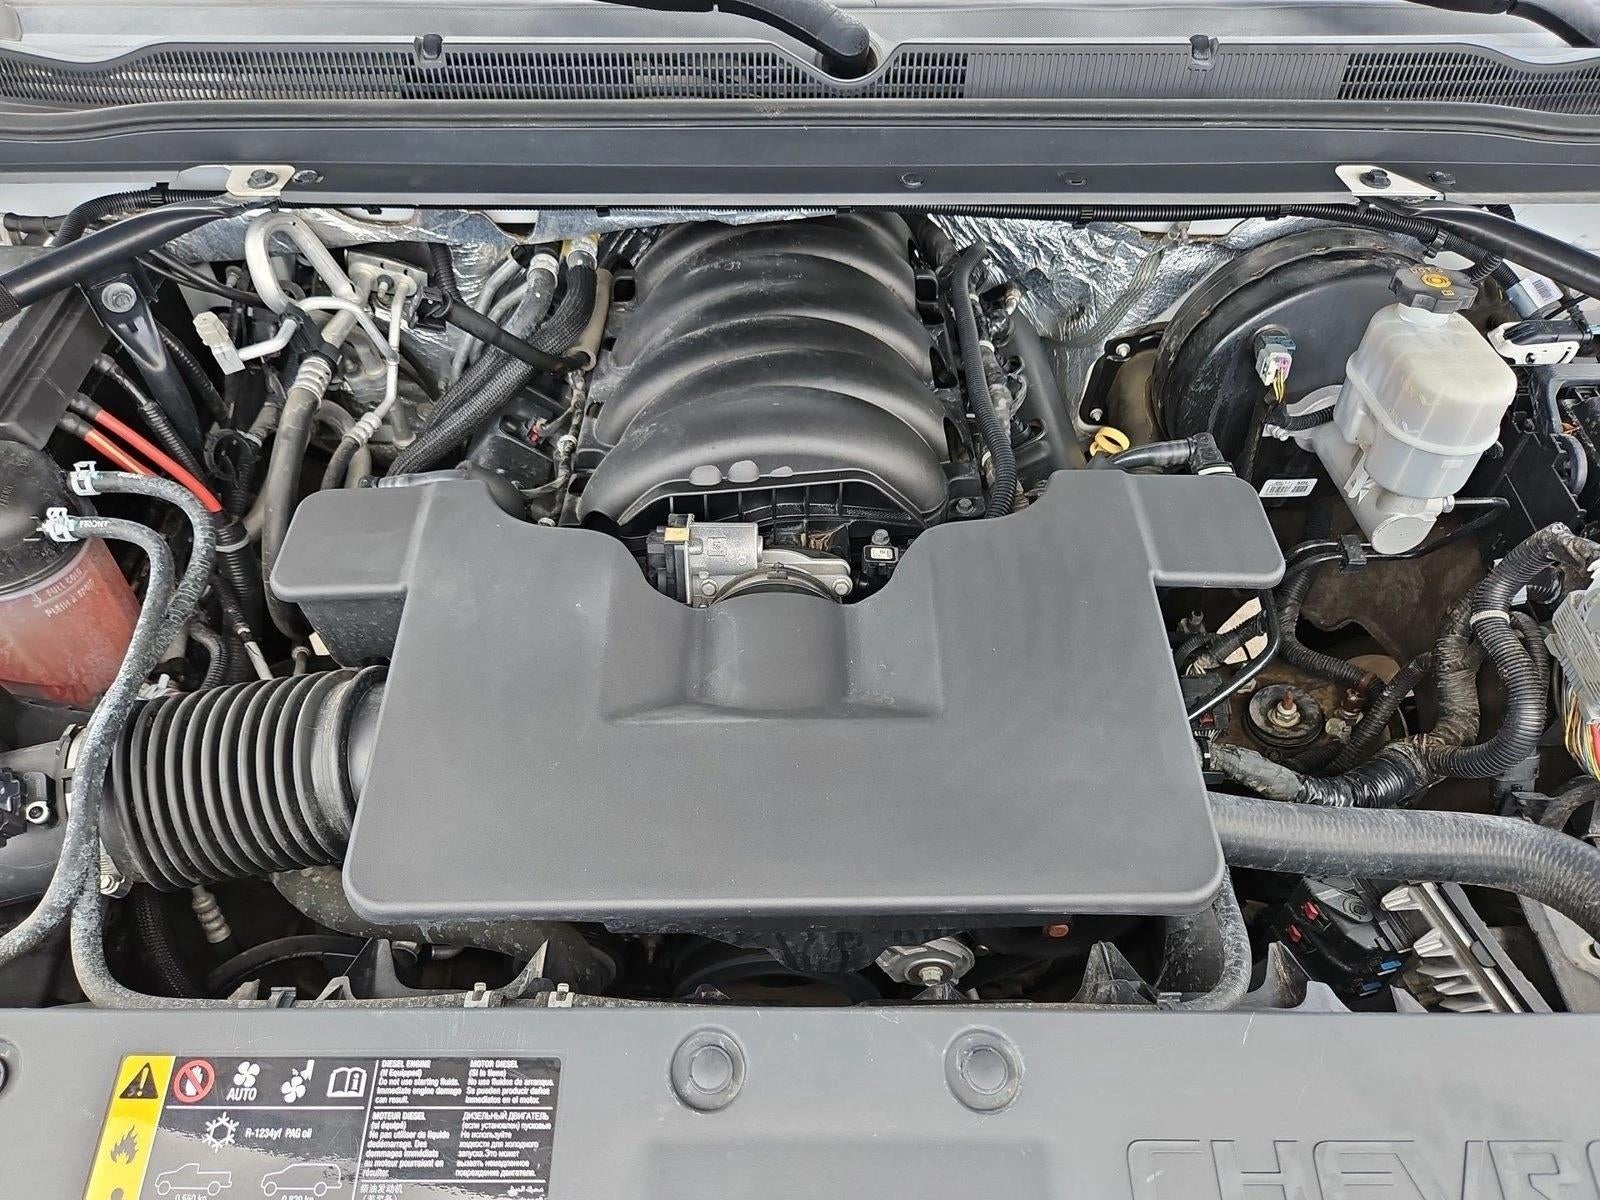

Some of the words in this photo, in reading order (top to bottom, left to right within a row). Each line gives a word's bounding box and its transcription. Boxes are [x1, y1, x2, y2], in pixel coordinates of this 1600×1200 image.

[79, 519, 110, 529] FRONT
[381, 1059, 405, 1068] DIESEL
[405, 1059, 431, 1068] ENGINE
[469, 1059, 494, 1068] MOTOR
[495, 1059, 518, 1068] DIESEL
[389, 1069, 422, 1078] Equipped)
[378, 1078, 388, 1086] Do
[388, 1078, 400, 1086] not
[413, 1078, 439, 1087] starting
[439, 1077, 460, 1086] fluids.
[467, 1078, 477, 1086] No
[491, 1077, 513, 1086] fluidos
[514, 1077, 523, 1086] de
[523, 1079, 554, 1087] arranque.
[226, 1087, 257, 1101] AUTO
[376, 1086, 411, 1095] Immediate
[412, 1087, 434, 1096] engine
[435, 1087, 462, 1096] damage
[466, 1086, 475, 1095] Se
[476, 1087, 501, 1096] pueden
[501, 1087, 529, 1096] producir
[374, 1096, 388, 1104] can
[388, 1095, 409, 1104] result.
[512, 1095, 518, 1104] el
[519, 1096, 540, 1104] motor.
[372, 1111, 401, 1120] MOTEUR
[402, 1111, 426, 1120] DIESEL
[462, 1110, 508, 1120] ДИЗЕЛЬНЫЙ
[508, 1112, 549, 1121] ДВИГАТЕЛЬ
[245, 1127, 282, 1140] R-1234yf
[285, 1127, 301, 1138] PAG
[301, 1127, 313, 1138] oil
[369, 1130, 379, 1139] Ne
[379, 1131, 392, 1140] pas
[393, 1130, 417, 1139] utiliser
[417, 1130, 426, 1139] de
[427, 1130, 450, 1140] liquide
[460, 1130, 470, 1139] Не
[414, 1140, 427, 1148] Des
[490, 1141, 504, 1149] для
[366, 1149, 403, 1159] dommages
[373, 1159, 398, 1168] moteur
[399, 1159, 434, 1169] pourraient
[434, 1160, 444, 1168] en
[1127, 1139, 1600, 1200] CHEVR
